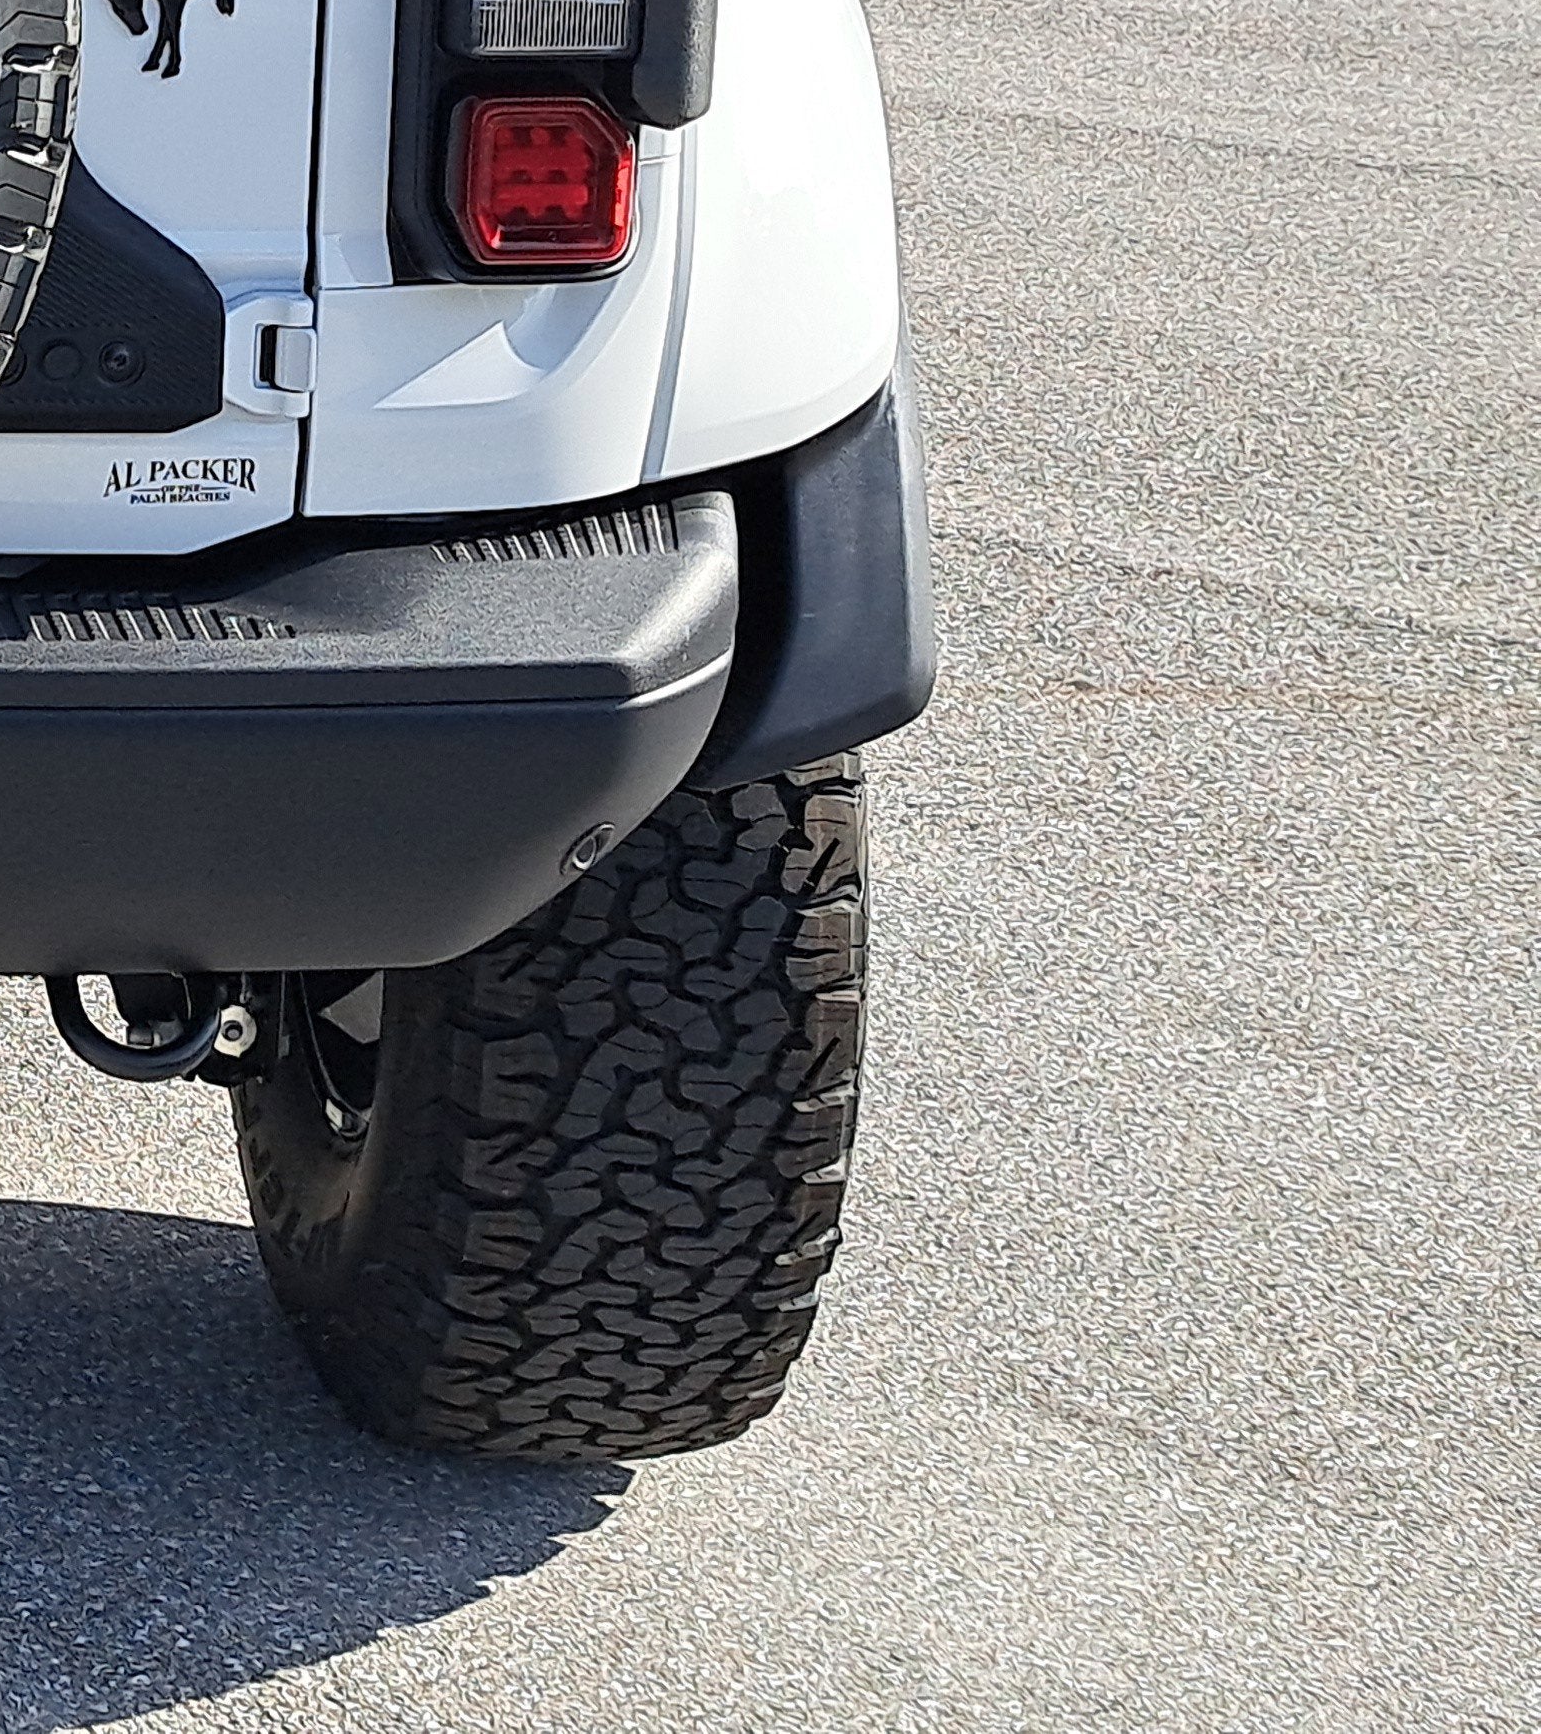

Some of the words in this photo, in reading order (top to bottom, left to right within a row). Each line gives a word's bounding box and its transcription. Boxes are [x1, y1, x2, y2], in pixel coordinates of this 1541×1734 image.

[102, 461, 141, 497] AL
[149, 457, 256, 494] PACKER
[130, 492, 165, 504] PALM
[169, 491, 230, 503] BEACHES
